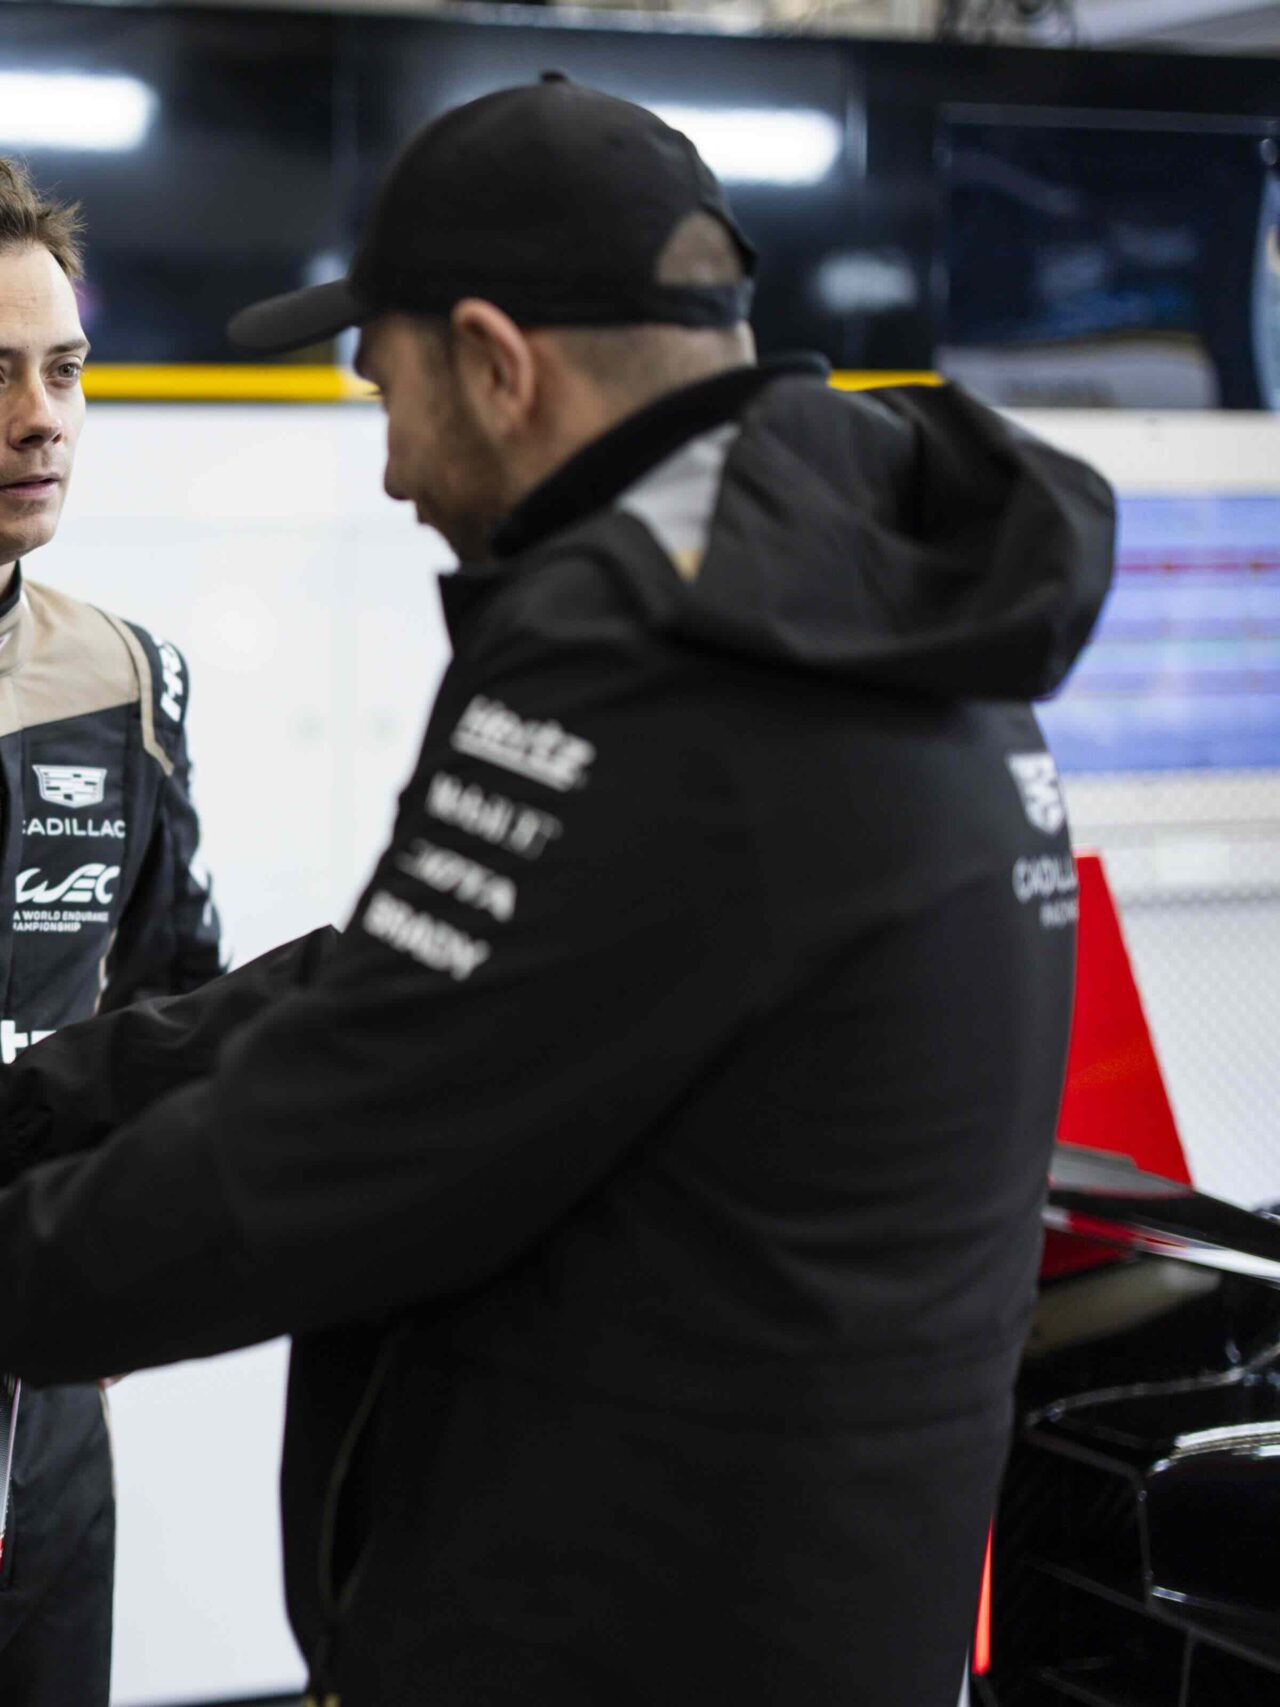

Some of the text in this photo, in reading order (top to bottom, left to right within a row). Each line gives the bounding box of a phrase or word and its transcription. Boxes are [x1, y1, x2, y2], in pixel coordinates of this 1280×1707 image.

[22, 818, 125, 838] ADILLAC
[16, 863, 121, 904] WEC
[22, 911, 61, 921] WORLD
